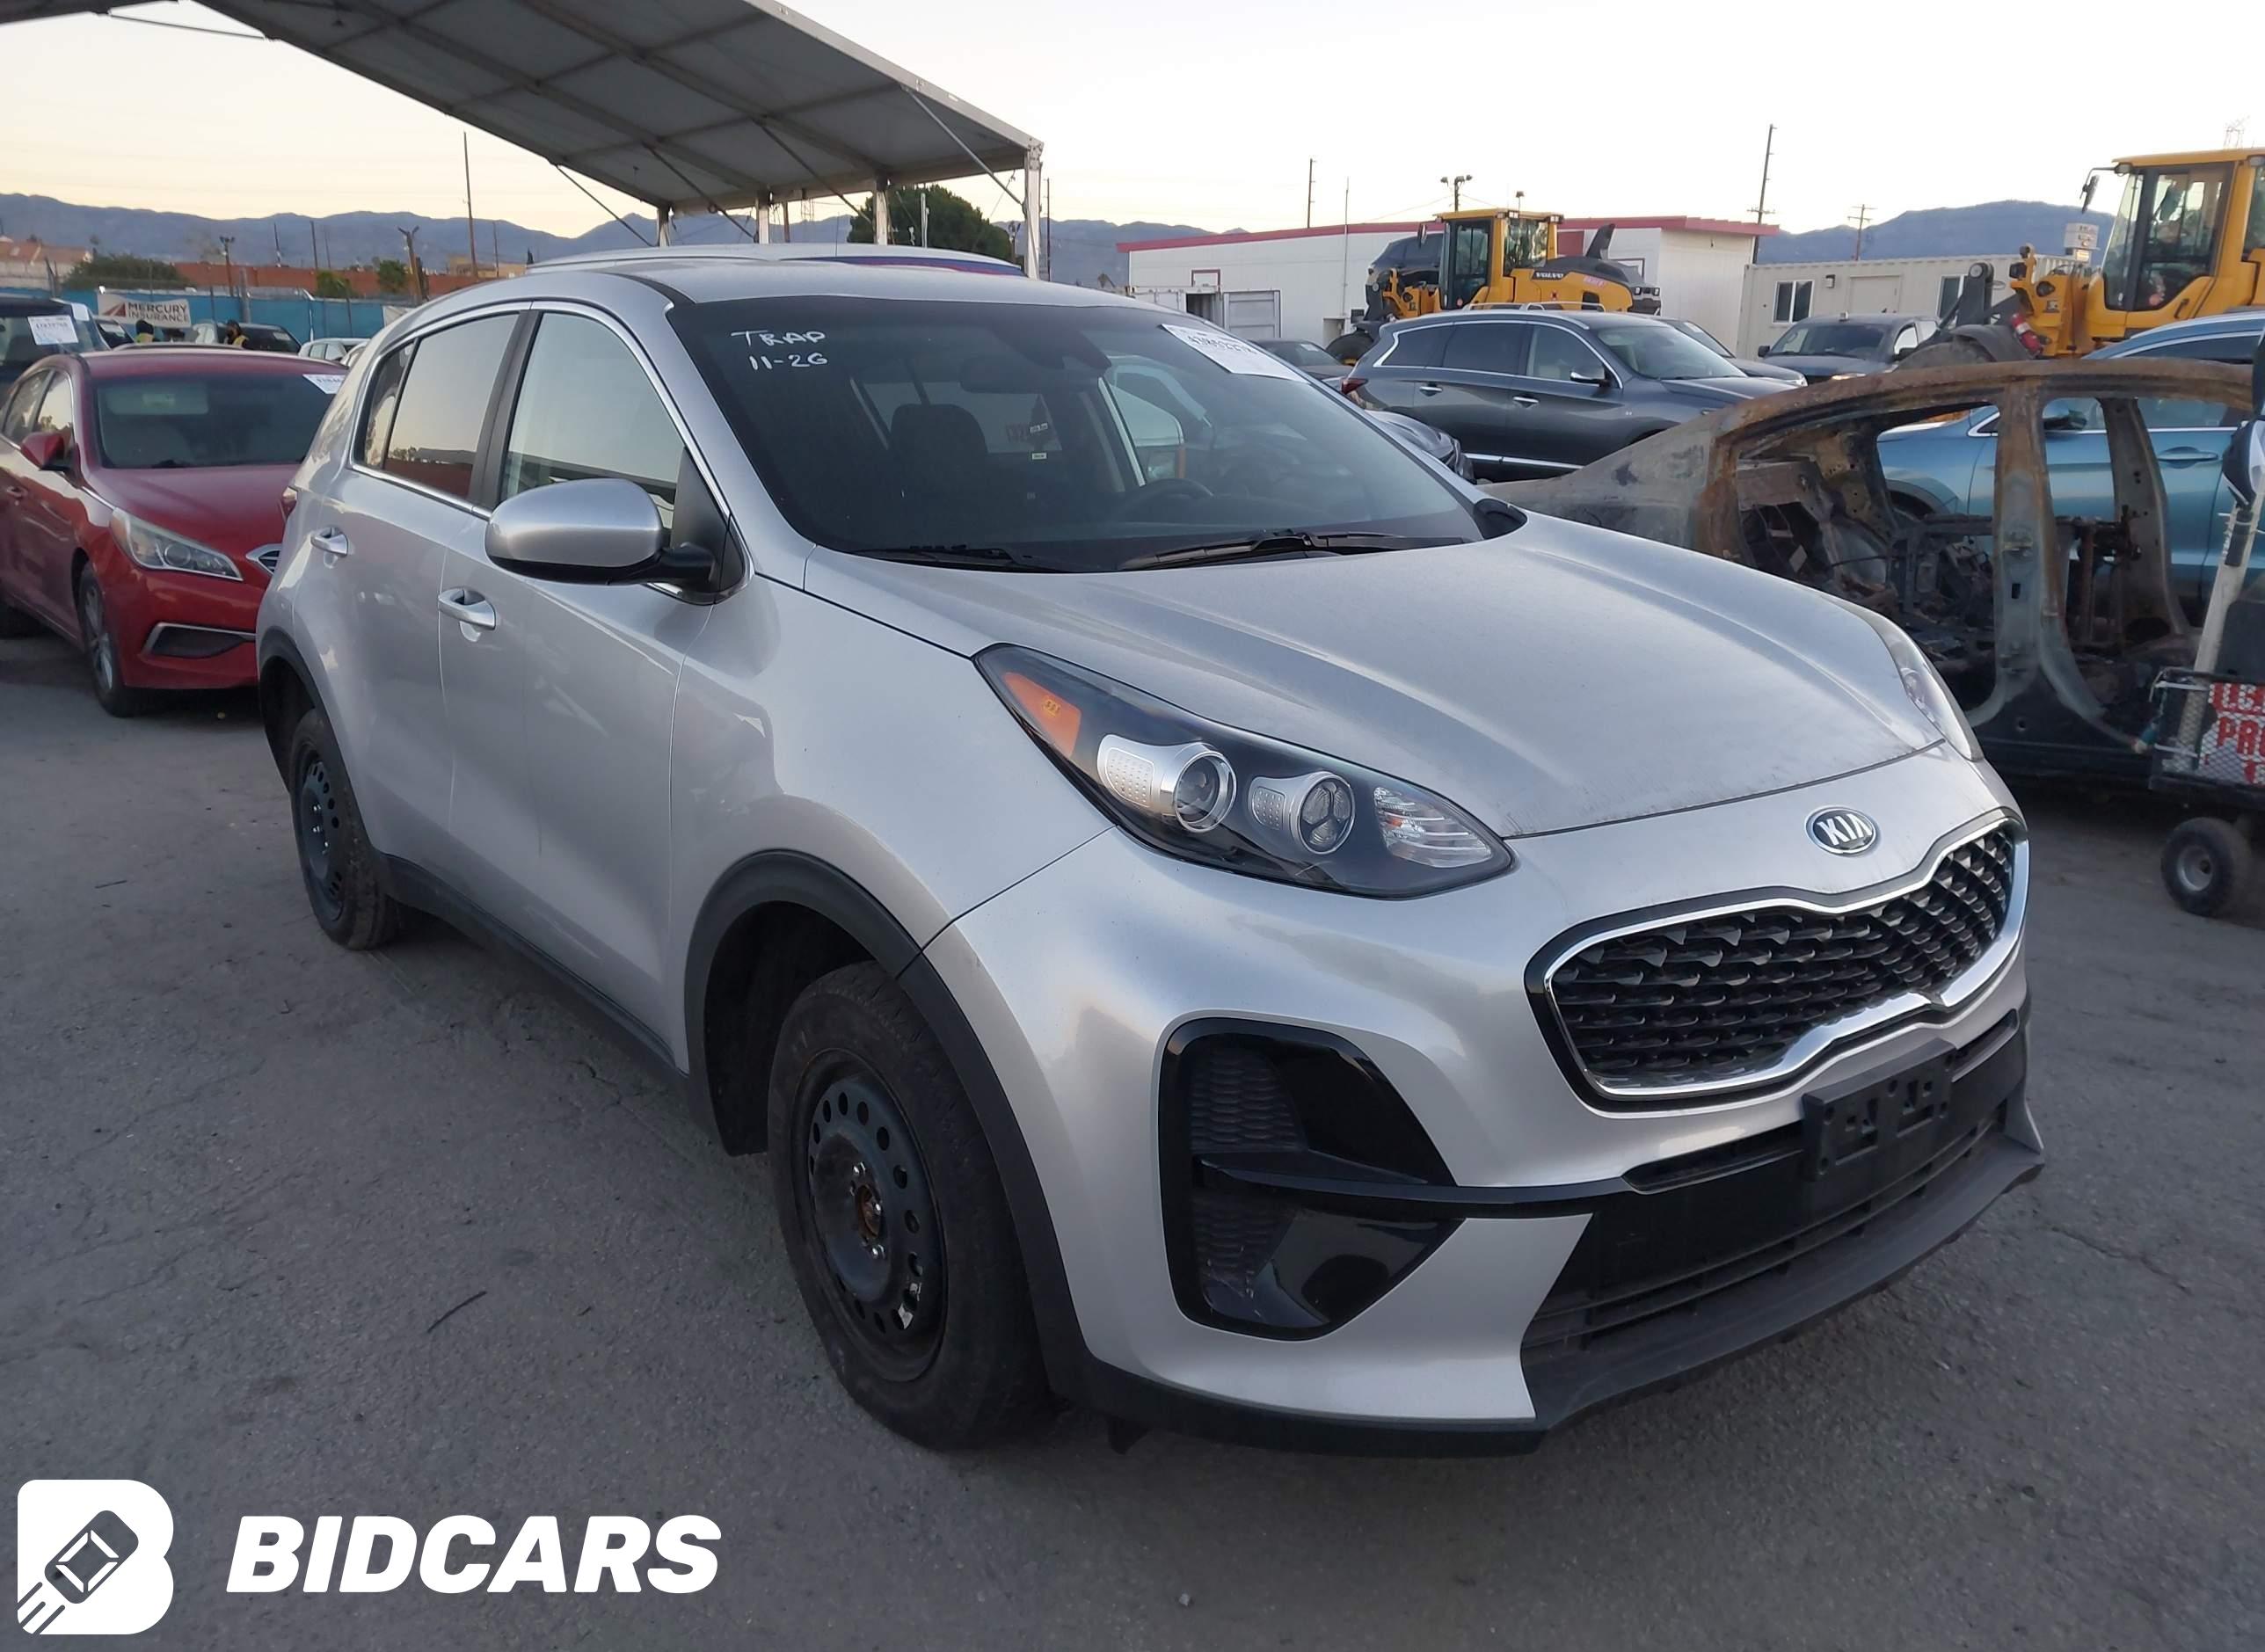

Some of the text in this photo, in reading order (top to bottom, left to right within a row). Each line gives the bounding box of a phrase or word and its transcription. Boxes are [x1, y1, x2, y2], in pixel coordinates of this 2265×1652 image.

[128, 302, 186, 314] MERCURY
[128, 311, 187, 323] INSURANCE
[731, 330, 826, 346] TRAP
[1817, 813, 1872, 845] KIA
